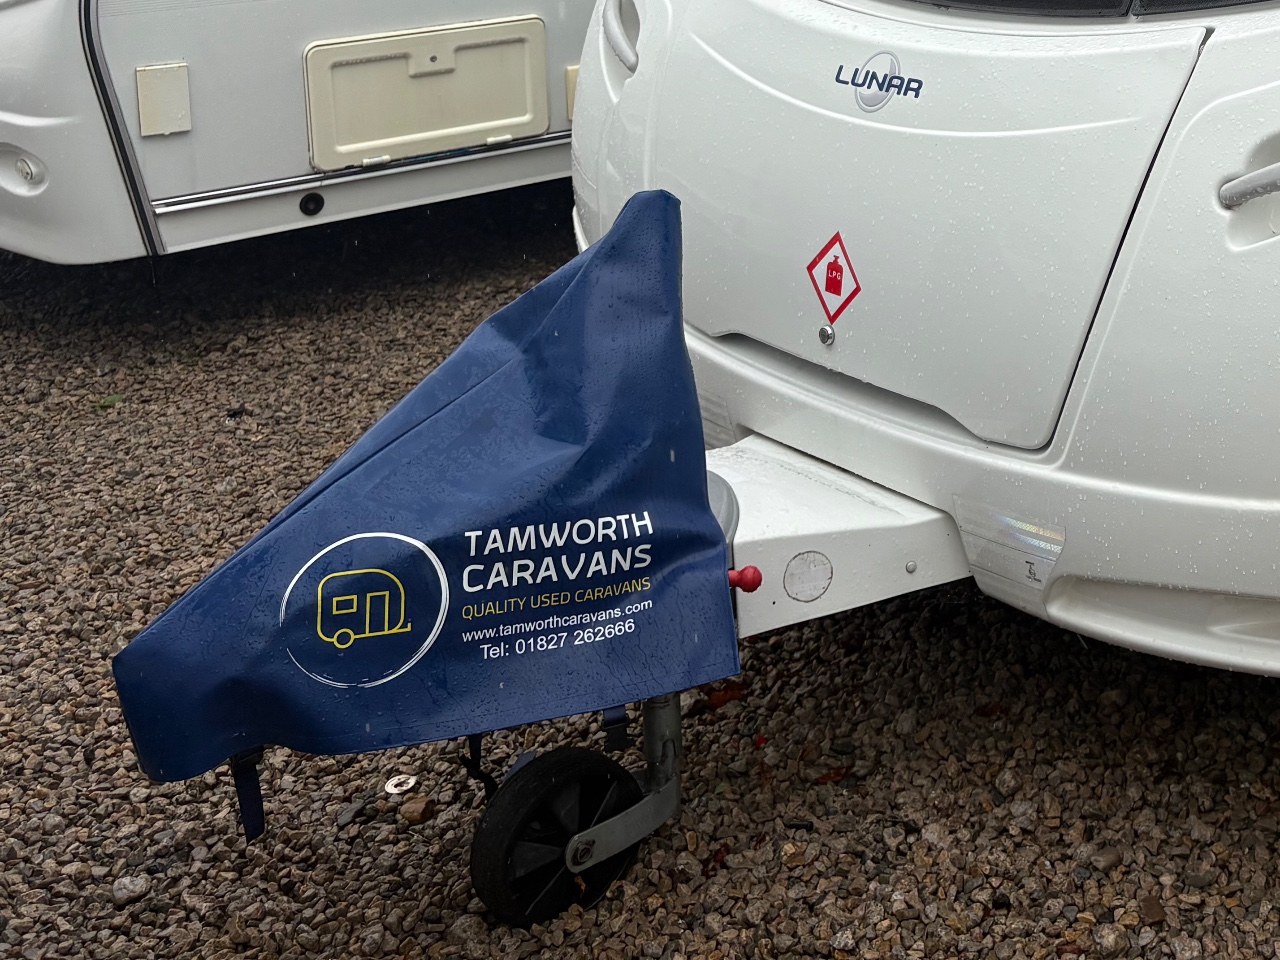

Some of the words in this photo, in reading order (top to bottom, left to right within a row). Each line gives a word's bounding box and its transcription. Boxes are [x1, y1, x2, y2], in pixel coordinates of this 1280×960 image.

[835, 64, 924, 99] LUNAR
[828, 269, 842, 280] LPG
[464, 511, 654, 557] TAMWORTH
[462, 543, 652, 593] CARAVANS
[462, 596, 527, 620] QUALITY
[530, 591, 571, 609] USED
[574, 576, 652, 603] CARAVANS
[462, 599, 653, 642] www.tamworthcaravans.com
[480, 643, 509, 659] Tel:
[515, 632, 568, 654] 01827
[573, 618, 635, 645] 262666
